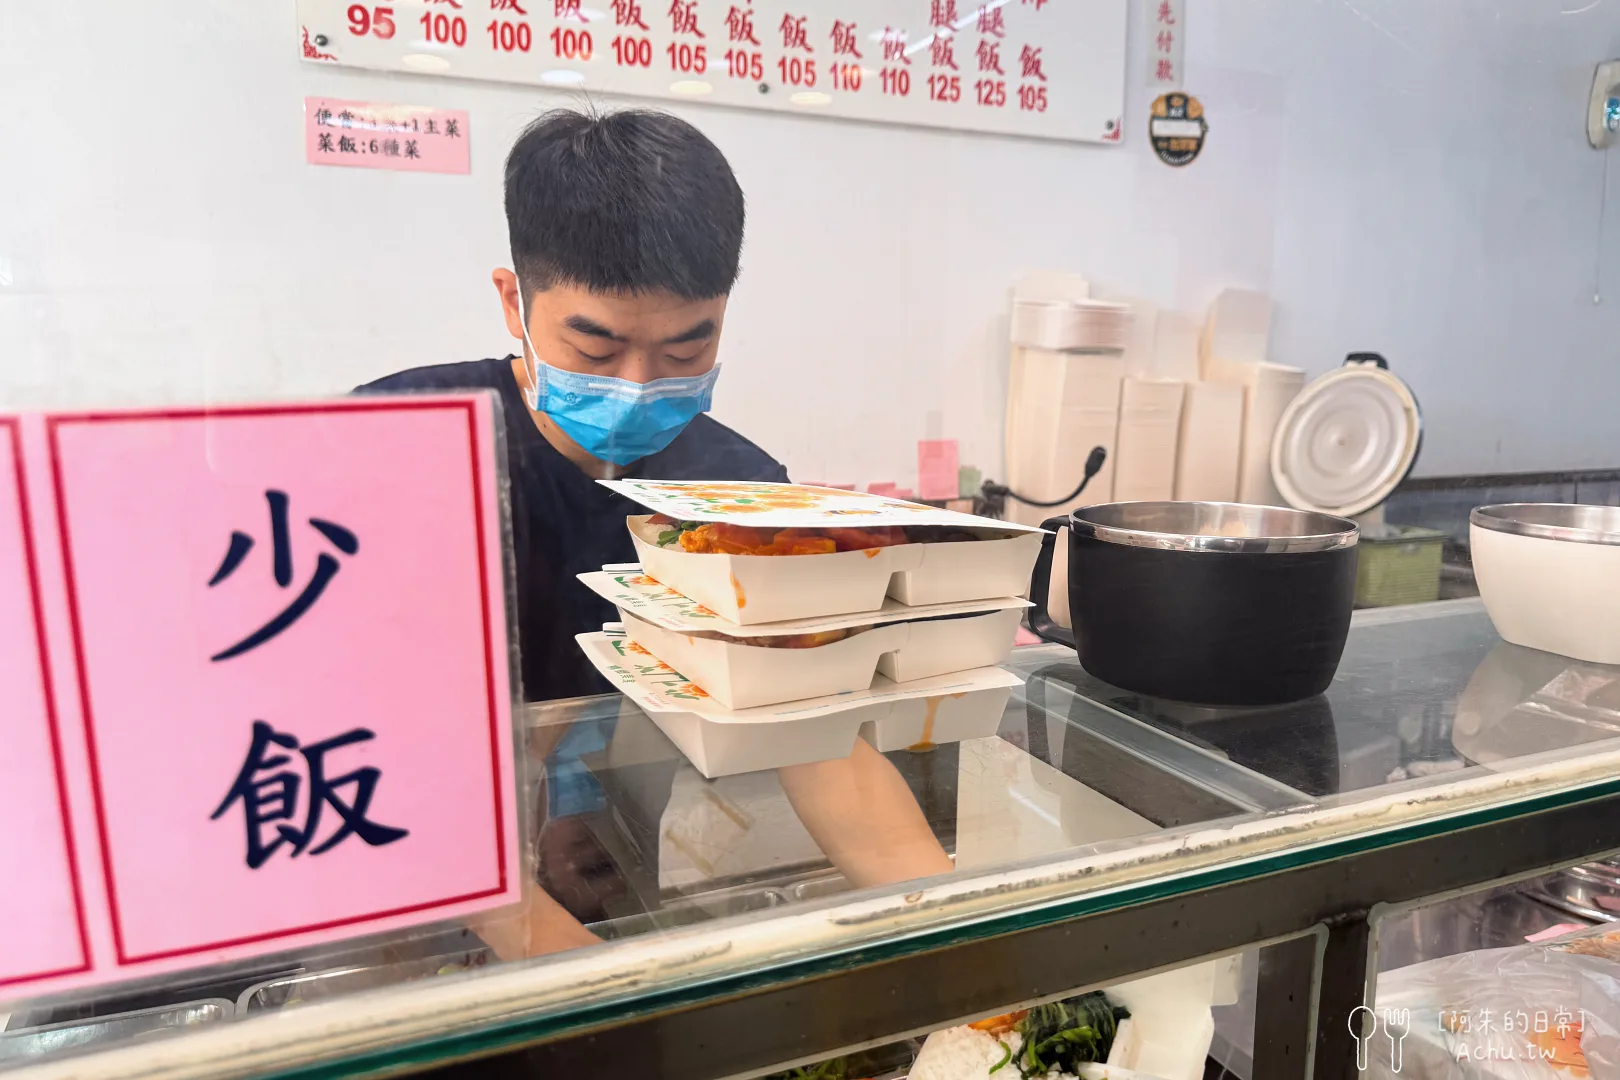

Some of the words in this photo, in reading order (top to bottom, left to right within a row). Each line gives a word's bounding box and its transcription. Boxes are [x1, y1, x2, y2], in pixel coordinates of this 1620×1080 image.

[346, 3, 397, 40] 95
[420, 10, 468, 48] 100
[610, 0, 651, 32] 飯
[667, 0, 707, 39] 飯
[725, 5, 761, 47] 飯
[779, 12, 814, 53] 飯
[486, 18, 533, 53] 100
[550, 26, 594, 62] 100
[611, 34, 653, 69] 100
[829, 19, 863, 59] 飯
[667, 41, 708, 76] 105
[724, 48, 765, 82] 105
[777, 56, 817, 88] 105
[1019, 45, 1048, 82] 飯
[829, 62, 863, 93] 110
[879, 66, 911, 97] 110
[927, 73, 961, 103] 125
[974, 79, 1007, 108] 125
[1017, 84, 1048, 113] 105
[209, 489, 409, 870] 少飯
